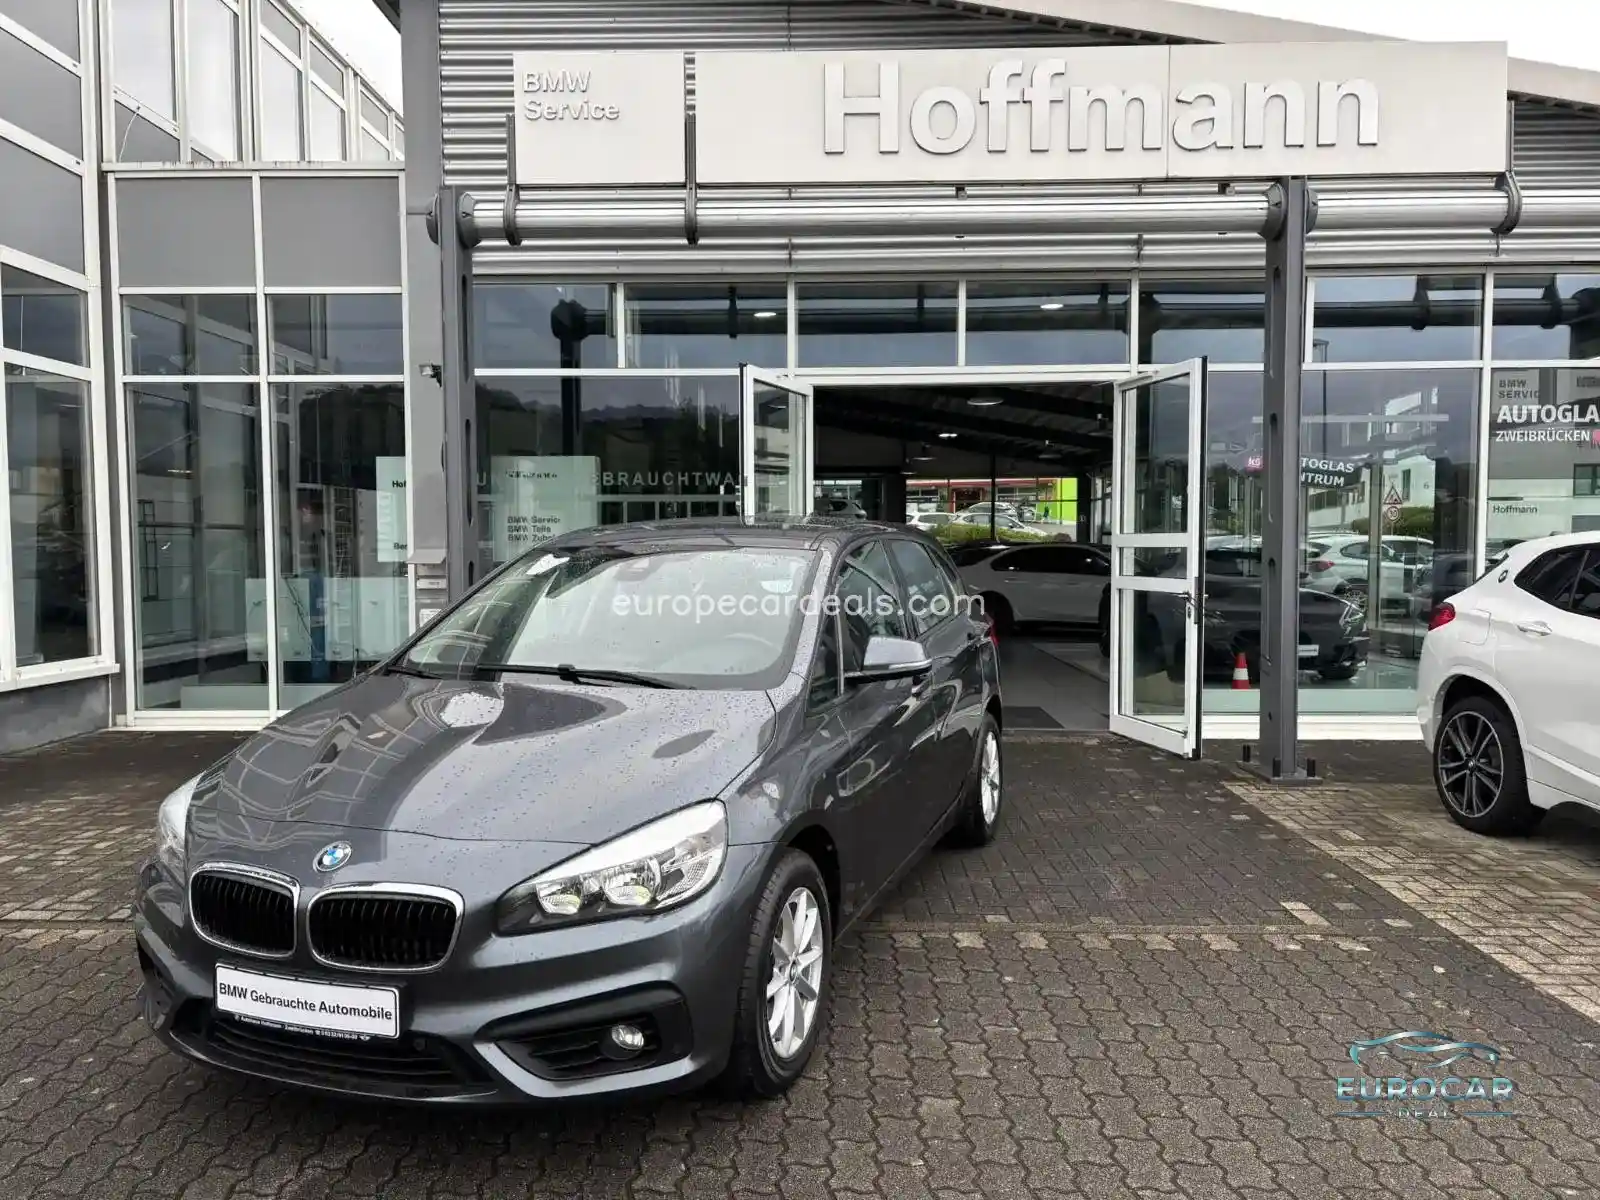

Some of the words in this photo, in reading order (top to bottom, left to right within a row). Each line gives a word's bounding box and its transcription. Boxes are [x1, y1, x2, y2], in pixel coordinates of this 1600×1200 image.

[522, 69, 591, 93] BMW
[524, 97, 620, 121] Service
[823, 58, 1380, 155] Hoffmann
[1495, 427, 1591, 442] ZWEIBRÜCKEN
[1300, 457, 1354, 473] TOGLAS
[1492, 504, 1538, 514] Hoffmann
[219, 982, 248, 1000] BMW
[250, 989, 317, 1013] Gebrauchte
[318, 1000, 393, 1021] Automobile
